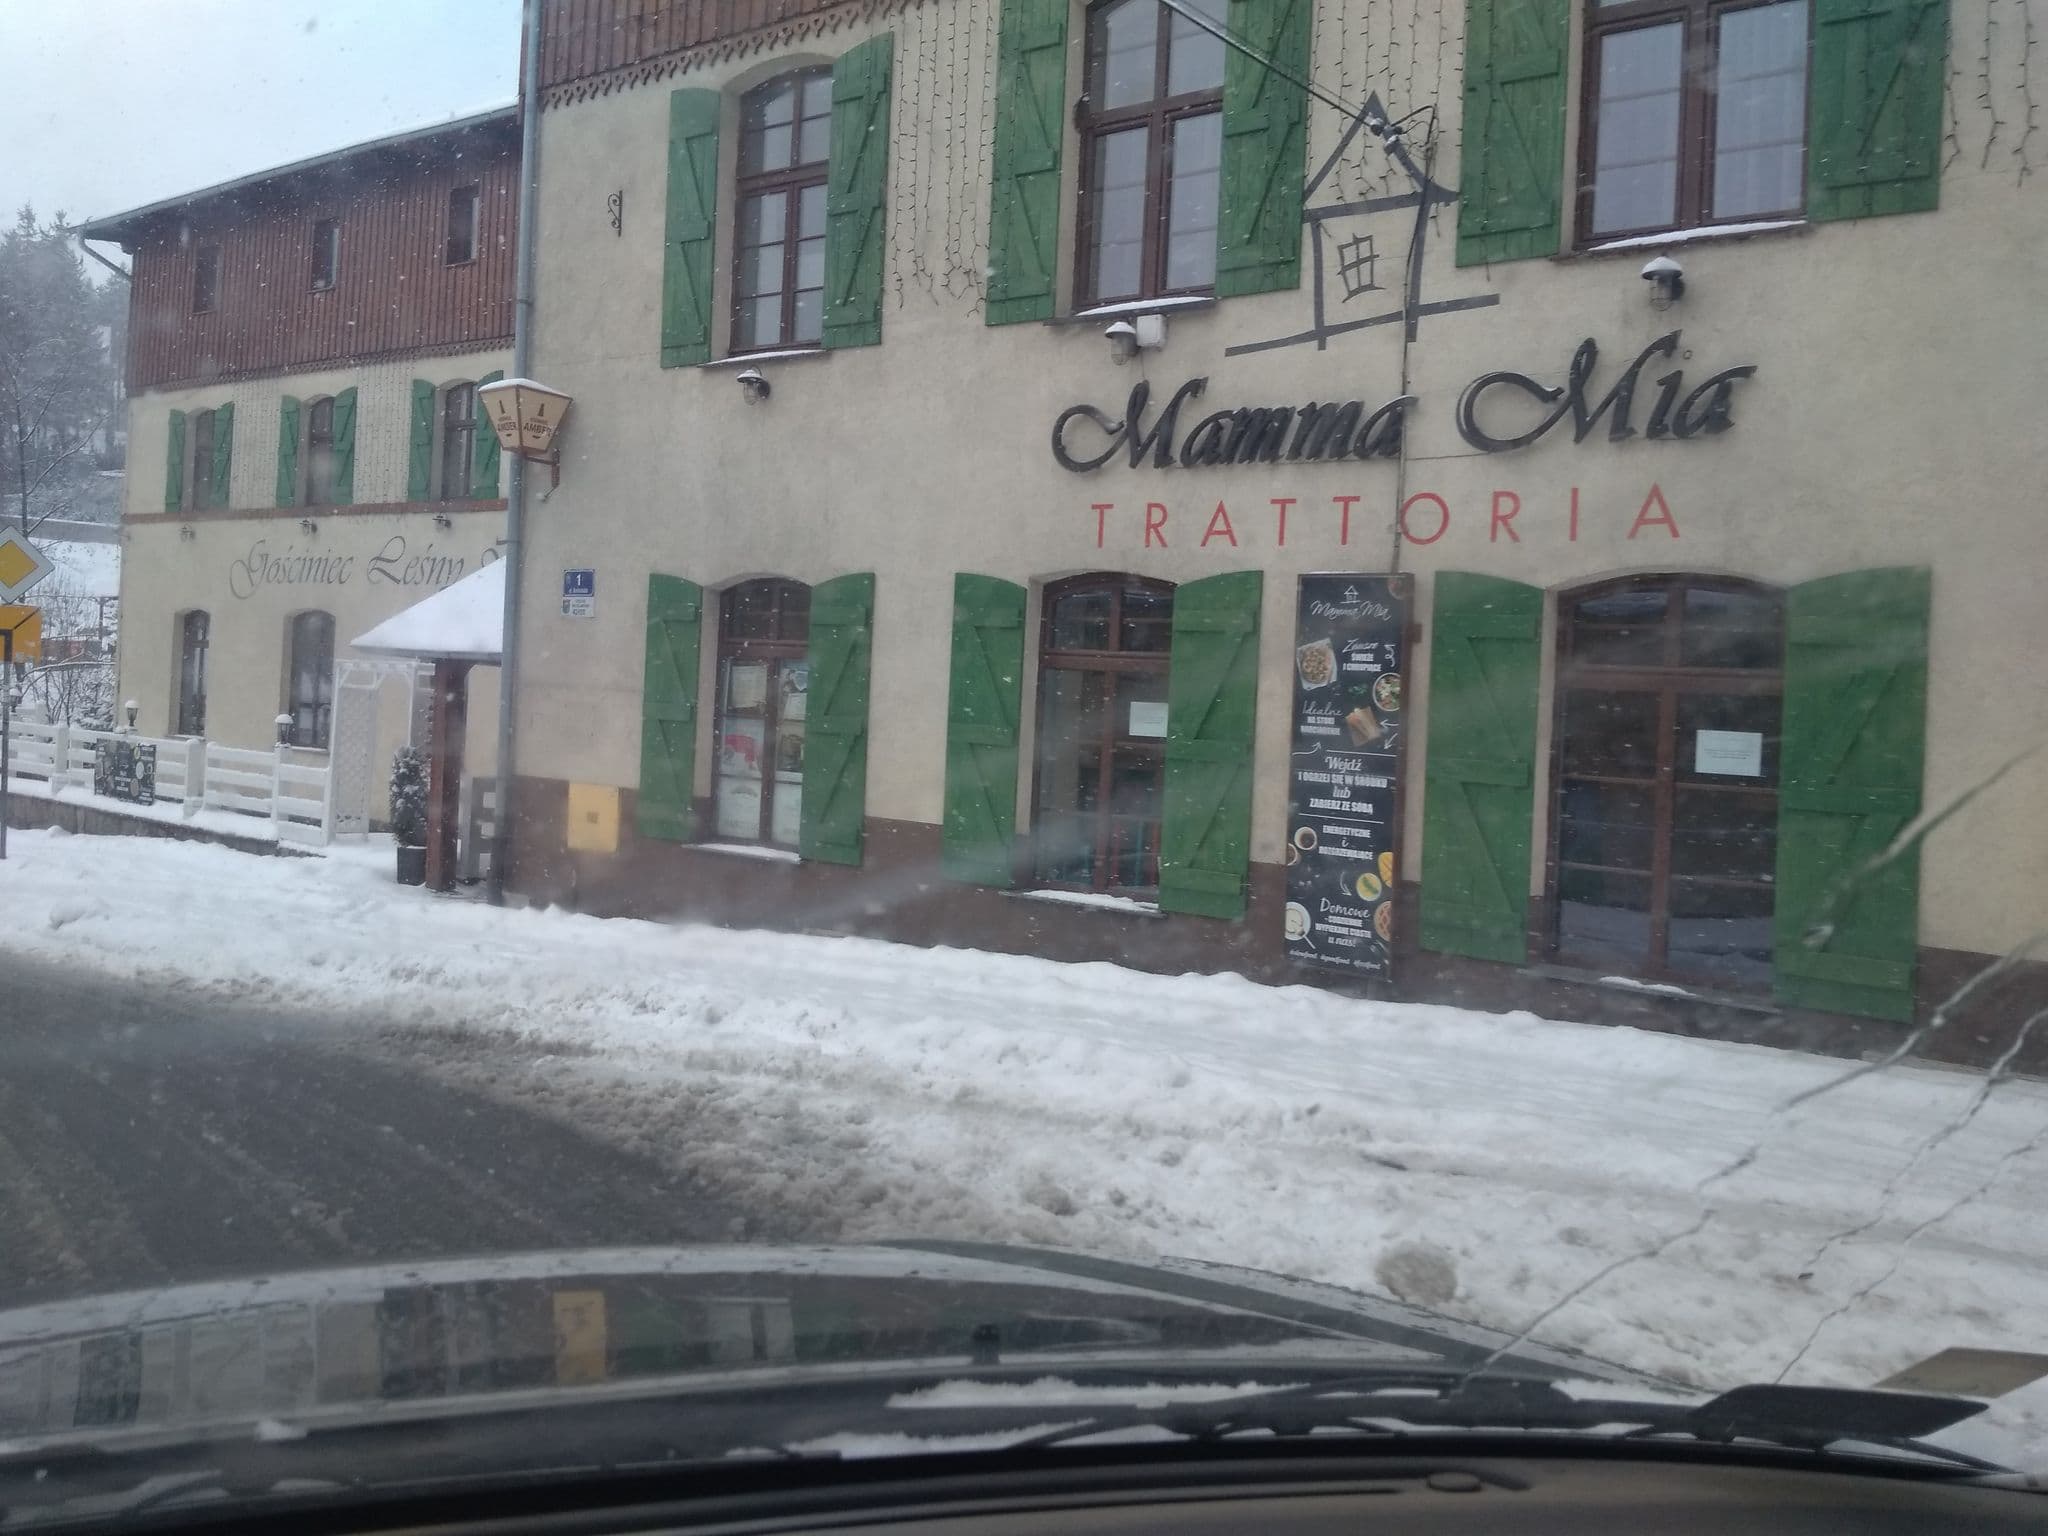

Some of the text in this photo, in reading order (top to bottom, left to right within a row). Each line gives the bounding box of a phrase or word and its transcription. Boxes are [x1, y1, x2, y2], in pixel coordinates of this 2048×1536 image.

[1051, 329, 1758, 473] Mamma Mia
[1091, 483, 1680, 549] TRATTORIA
[229, 540, 355, 600] Gościniec
[576, 573, 582, 586] 1
[1325, 756, 1362, 773] Wejdź
[1344, 774, 1353, 785] W
[1332, 786, 1351, 799] lub
[1341, 837, 1350, 847] i
[1320, 897, 1371, 919] Domowe
